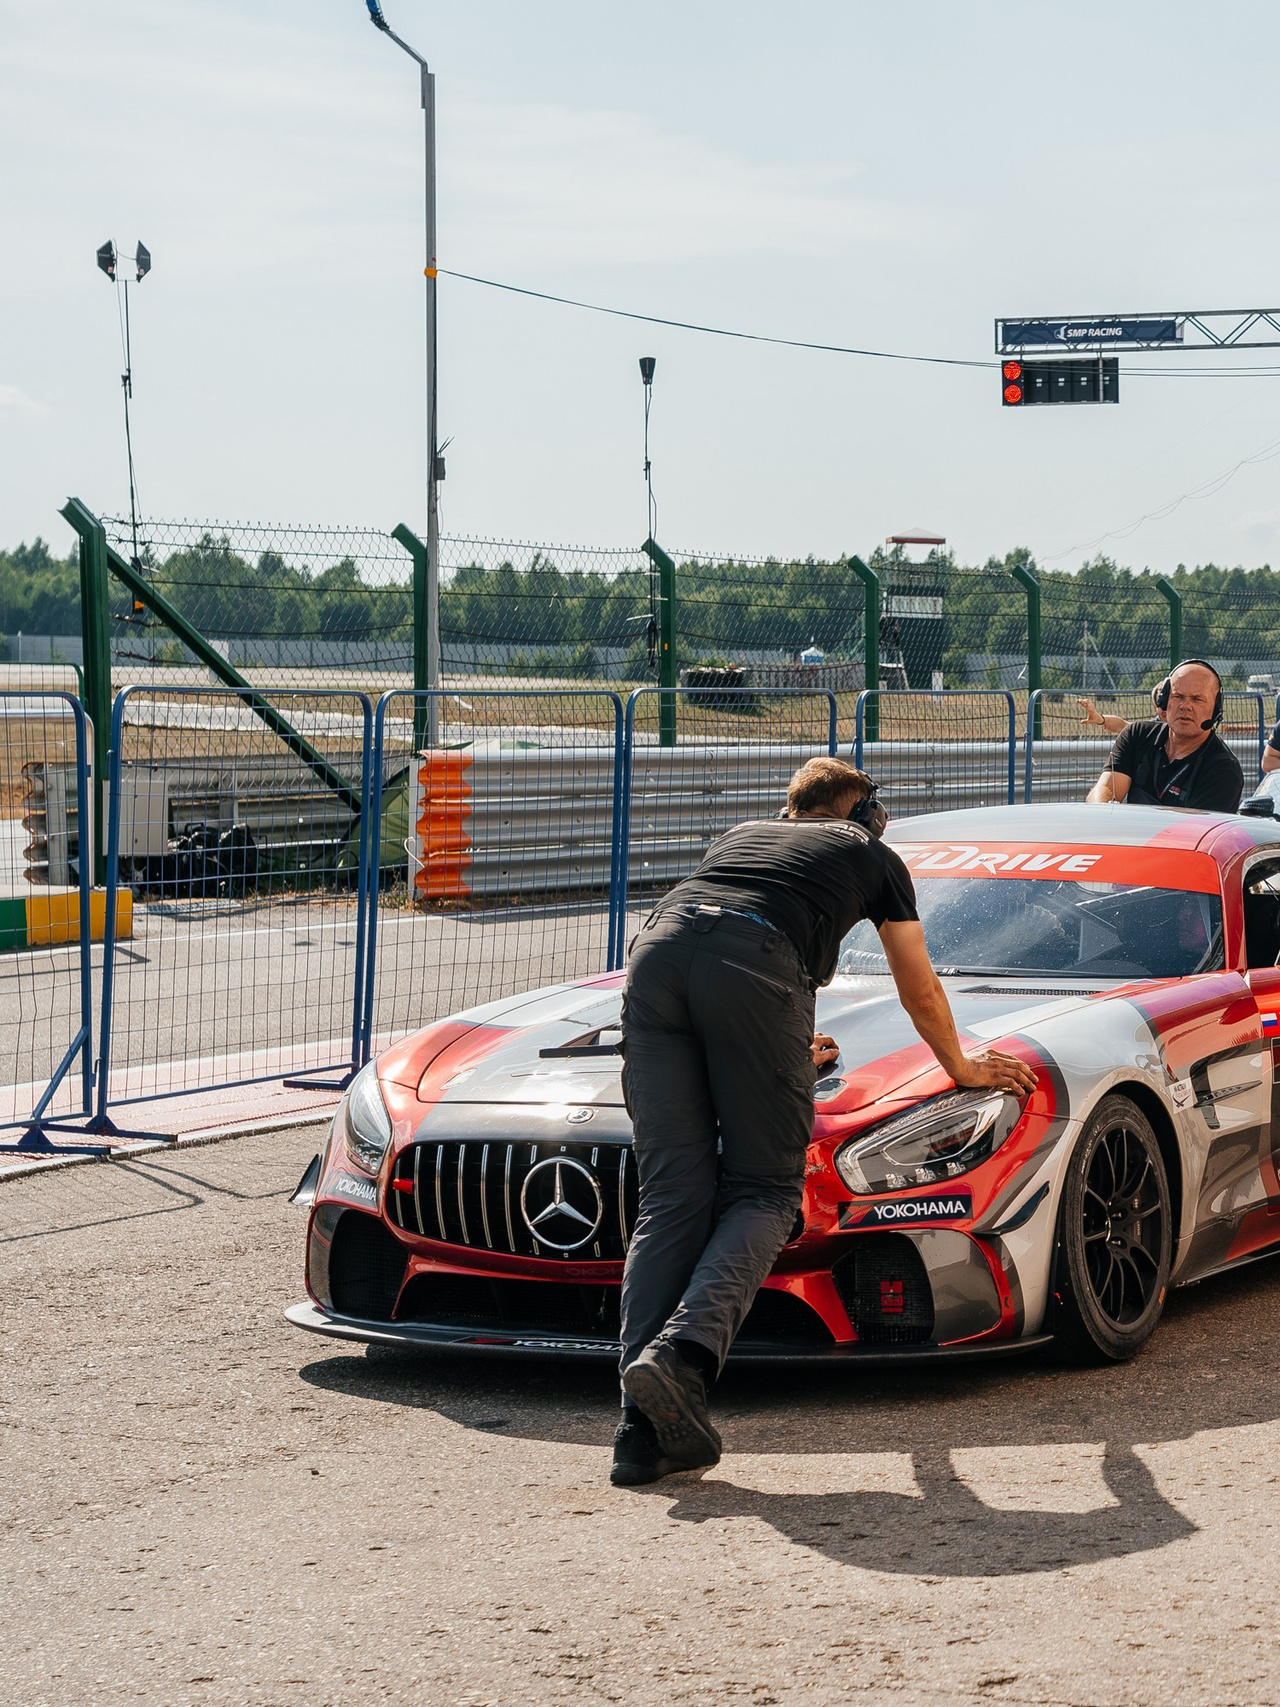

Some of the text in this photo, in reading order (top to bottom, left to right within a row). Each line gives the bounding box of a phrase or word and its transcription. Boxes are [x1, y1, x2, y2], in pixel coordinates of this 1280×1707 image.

[1067, 327, 1122, 338] SMP RACING
[335, 1177, 377, 1202] YOKOHAMA
[873, 1200, 966, 1220] YOKOHAMA
